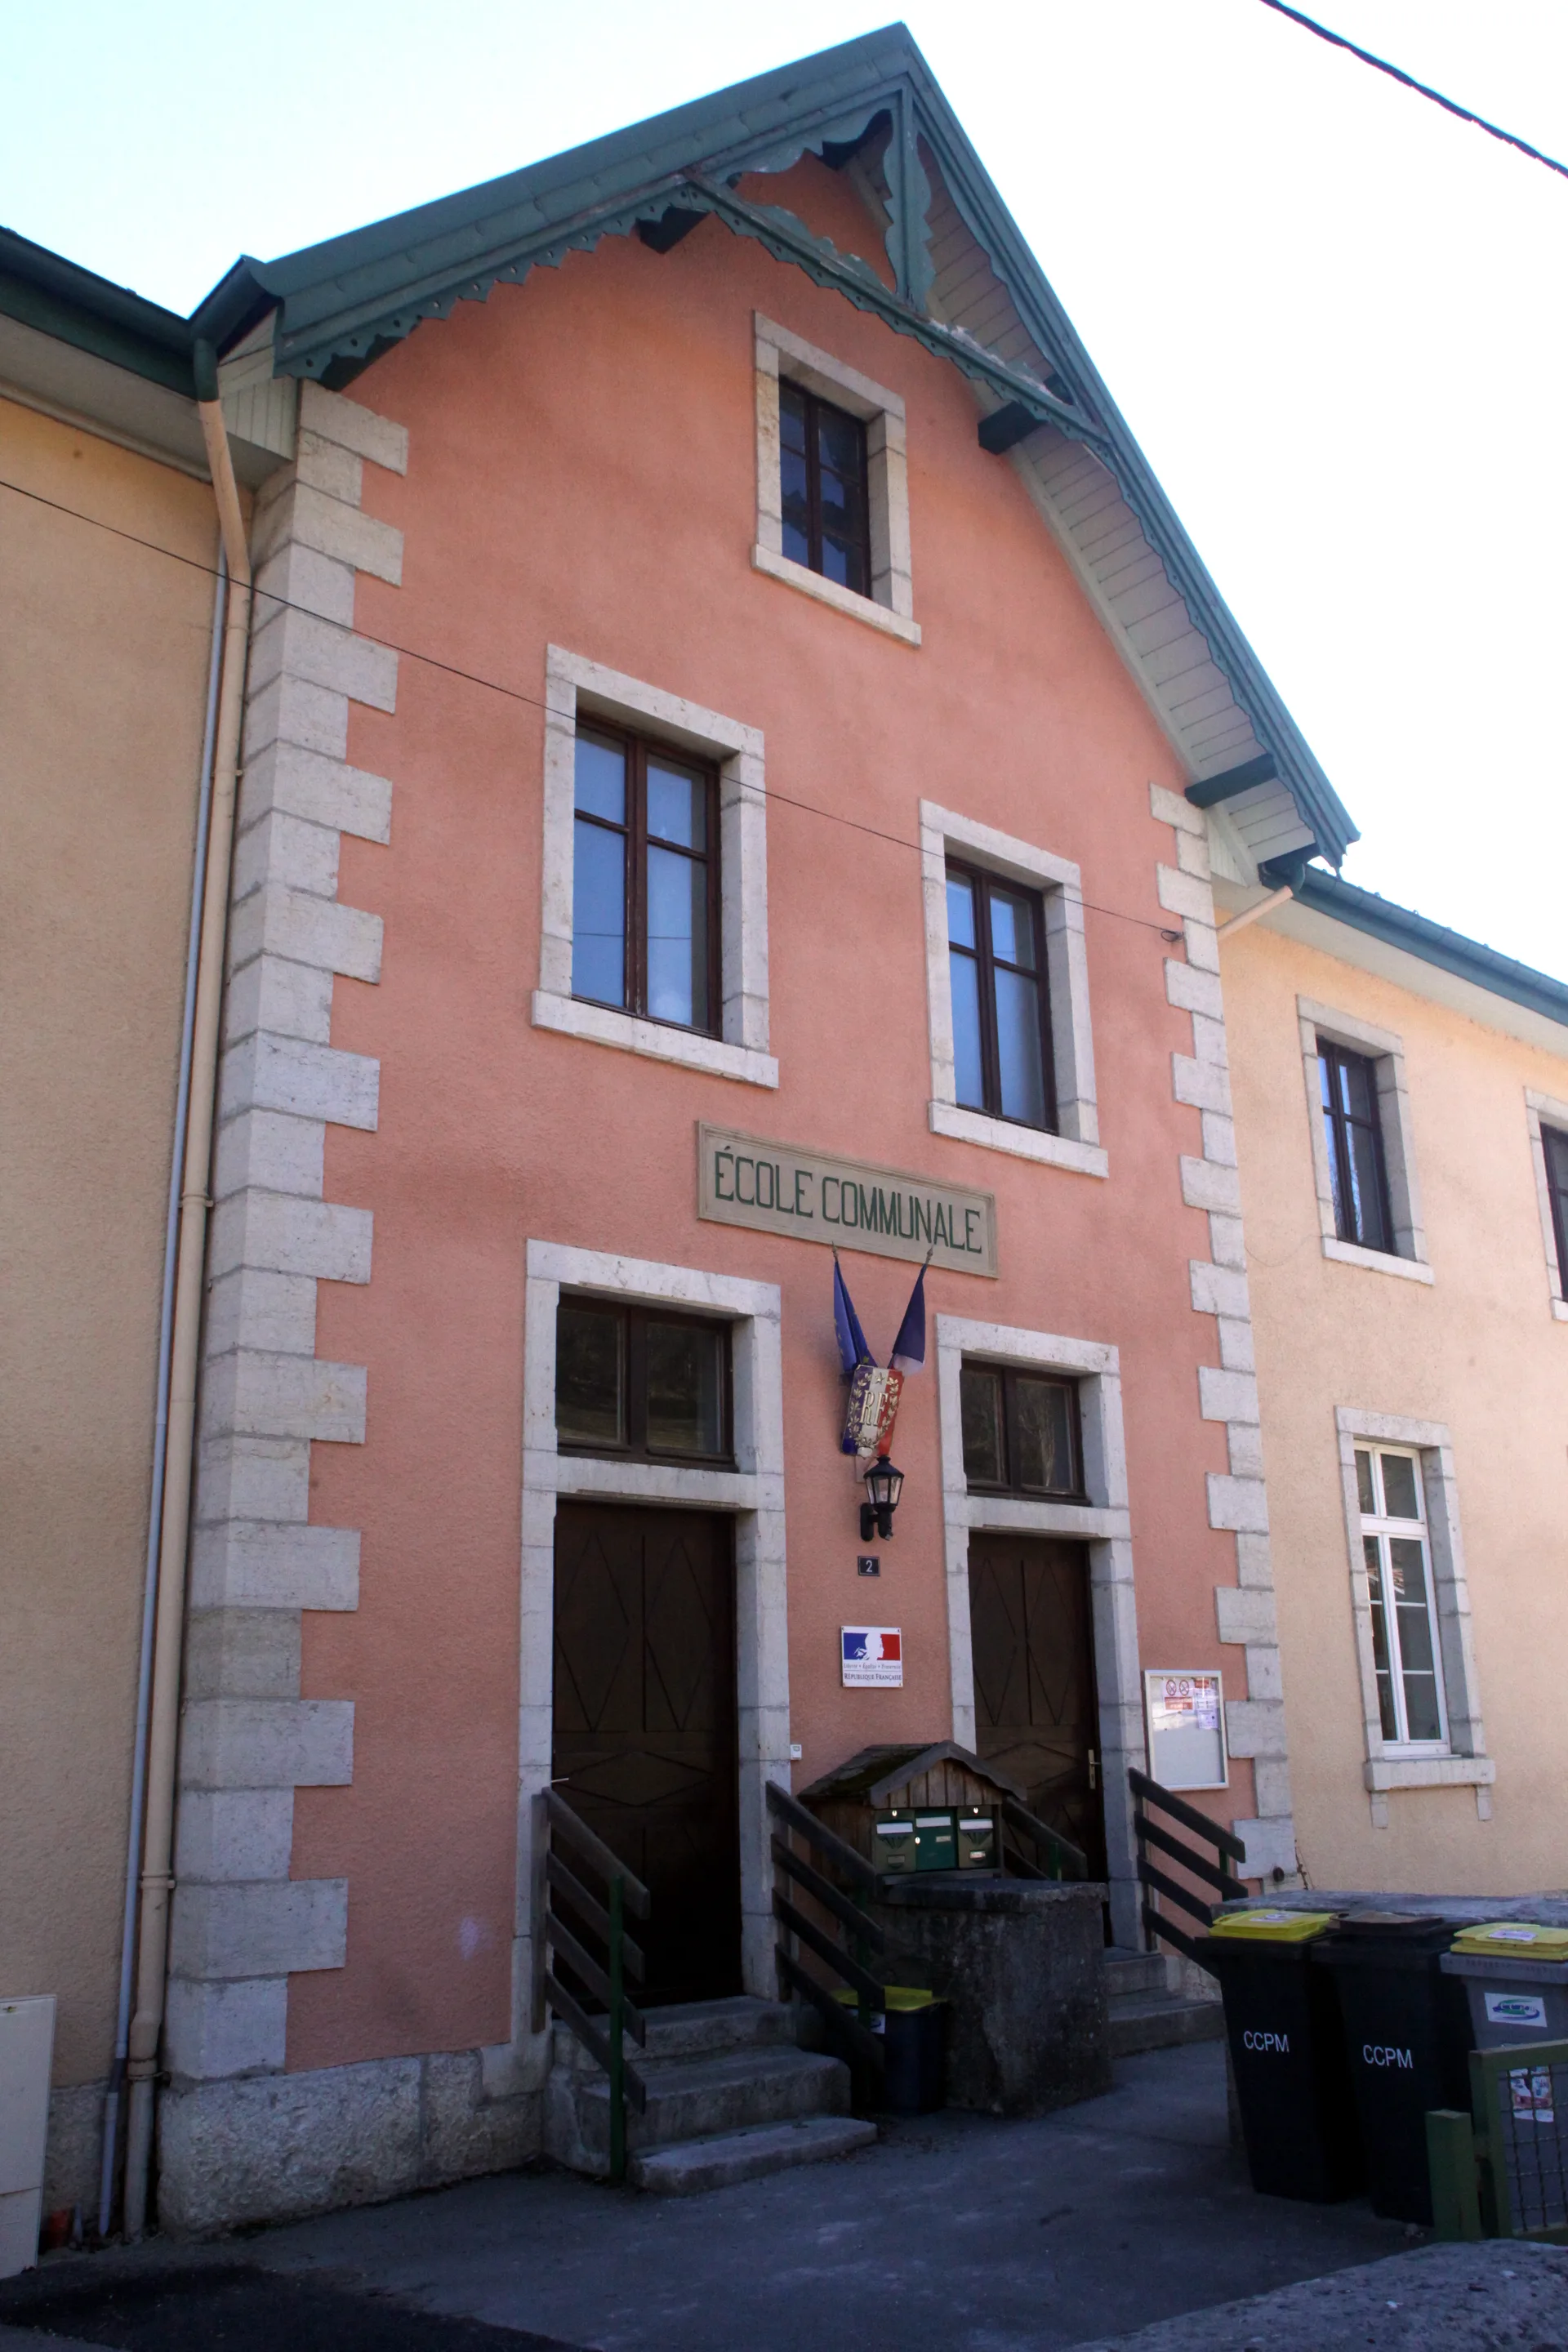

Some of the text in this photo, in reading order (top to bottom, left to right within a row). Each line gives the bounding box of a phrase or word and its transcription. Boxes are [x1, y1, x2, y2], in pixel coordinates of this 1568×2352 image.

[715, 1146, 982, 1254] ÉCOLE COMMUNALE
[859, 1390, 889, 1427] RF
[866, 1560, 873, 1573] 2
[844, 1673, 875, 1681] RÉPUBLIQUE
[1243, 2030, 1290, 2052] CCPM
[1363, 2044, 1414, 2069] CCPM
